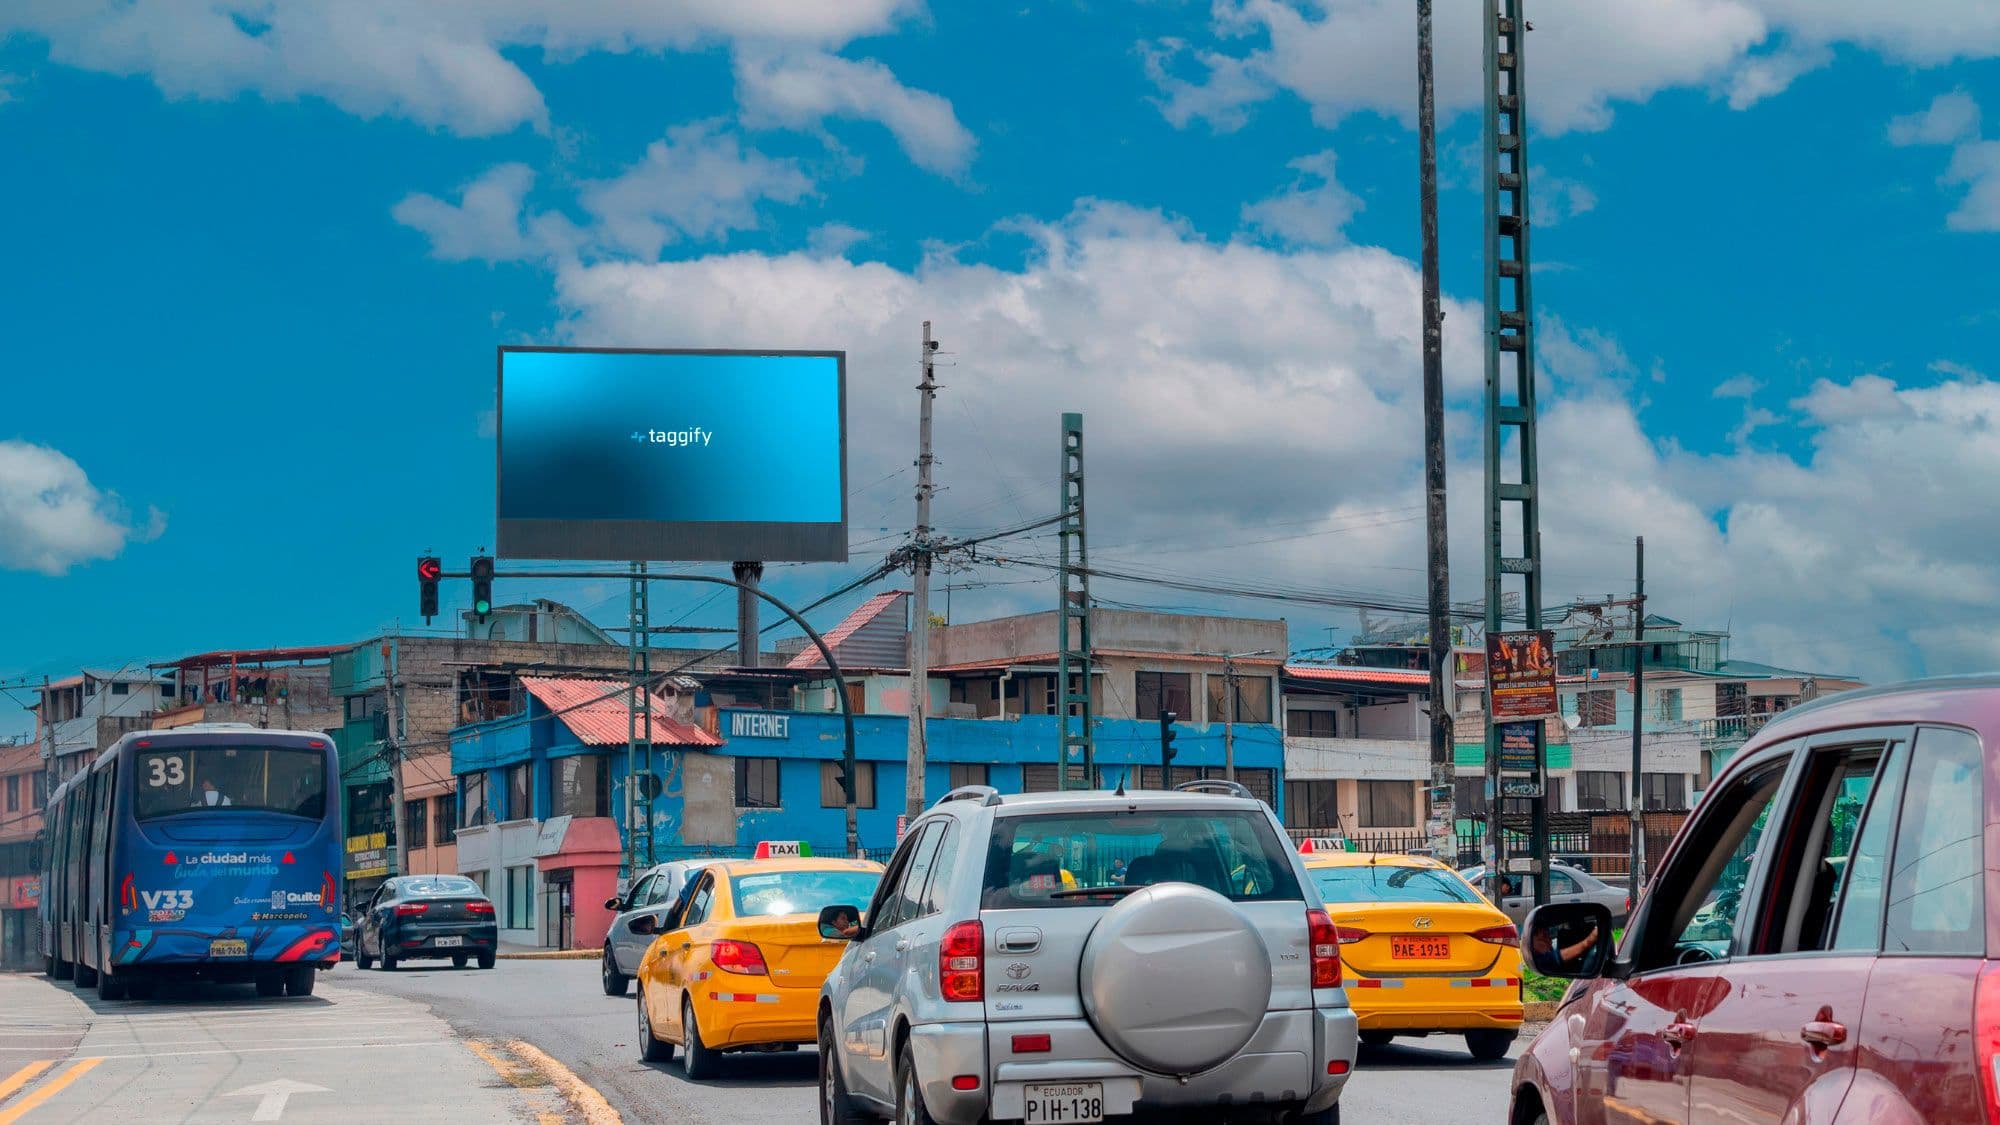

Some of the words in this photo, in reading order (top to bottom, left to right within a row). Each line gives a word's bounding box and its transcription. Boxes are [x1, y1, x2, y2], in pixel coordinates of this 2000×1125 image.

[648, 427, 713, 447] taggify
[732, 712, 790, 738] INTERNET
[148, 756, 185, 787] 33
[770, 844, 799, 855] TAXI
[1312, 839, 1345, 850] TAXI
[185, 855, 198, 865] La
[200, 851, 247, 865] ciudad
[249, 853, 272, 864] más
[228, 864, 279, 876] mundo
[141, 889, 194, 910] V33
[286, 891, 321, 903] Quito
[261, 912, 308, 920] Marcopolo
[1394, 943, 1449, 956] PAE-1915
[1043, 1087, 1084, 1097] ECUADOR
[1027, 1098, 1101, 1121] PIH-138
